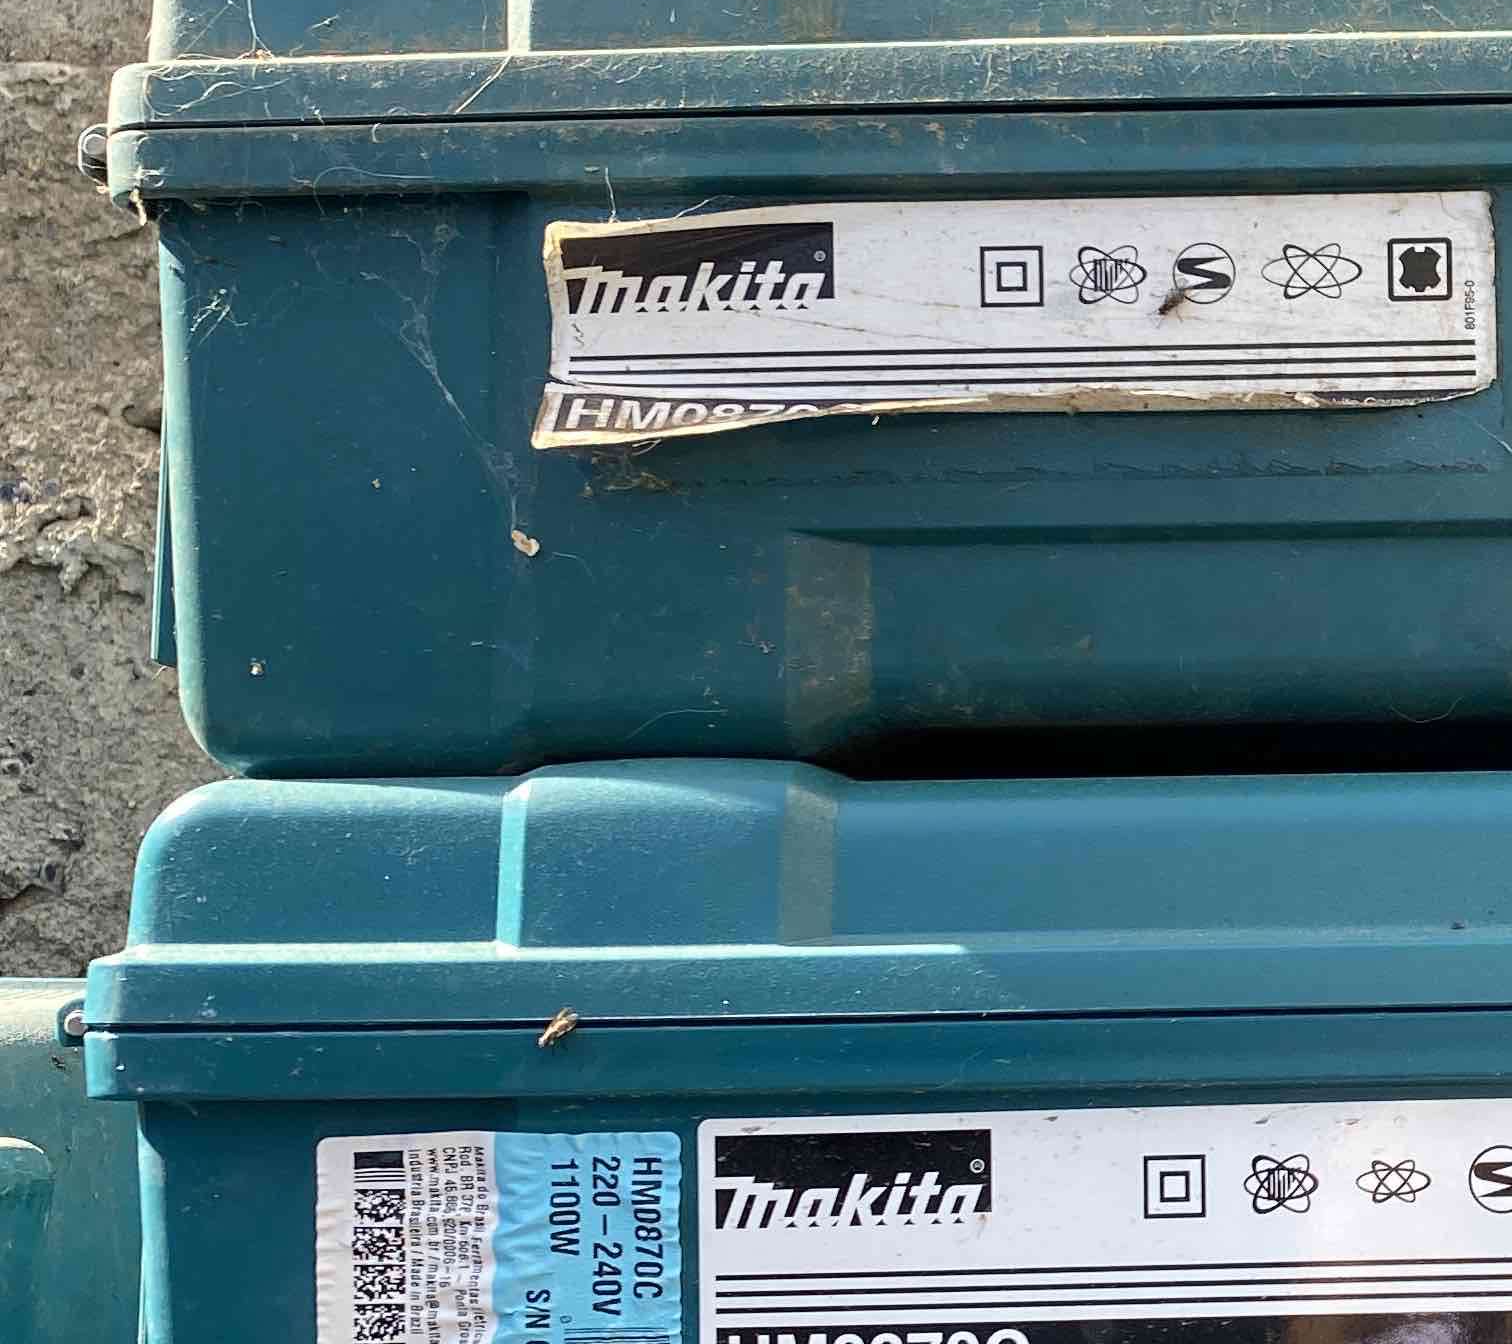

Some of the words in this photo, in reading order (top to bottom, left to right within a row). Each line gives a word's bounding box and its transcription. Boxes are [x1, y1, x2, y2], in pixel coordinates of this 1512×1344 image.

[460, 1175, 474, 1191] BR
[549, 1158, 581, 1256] 1100W
[631, 1157, 664, 1299] HM0870C
[410, 1258, 423, 1288] Made
[524, 1288, 551, 1329] S/N
